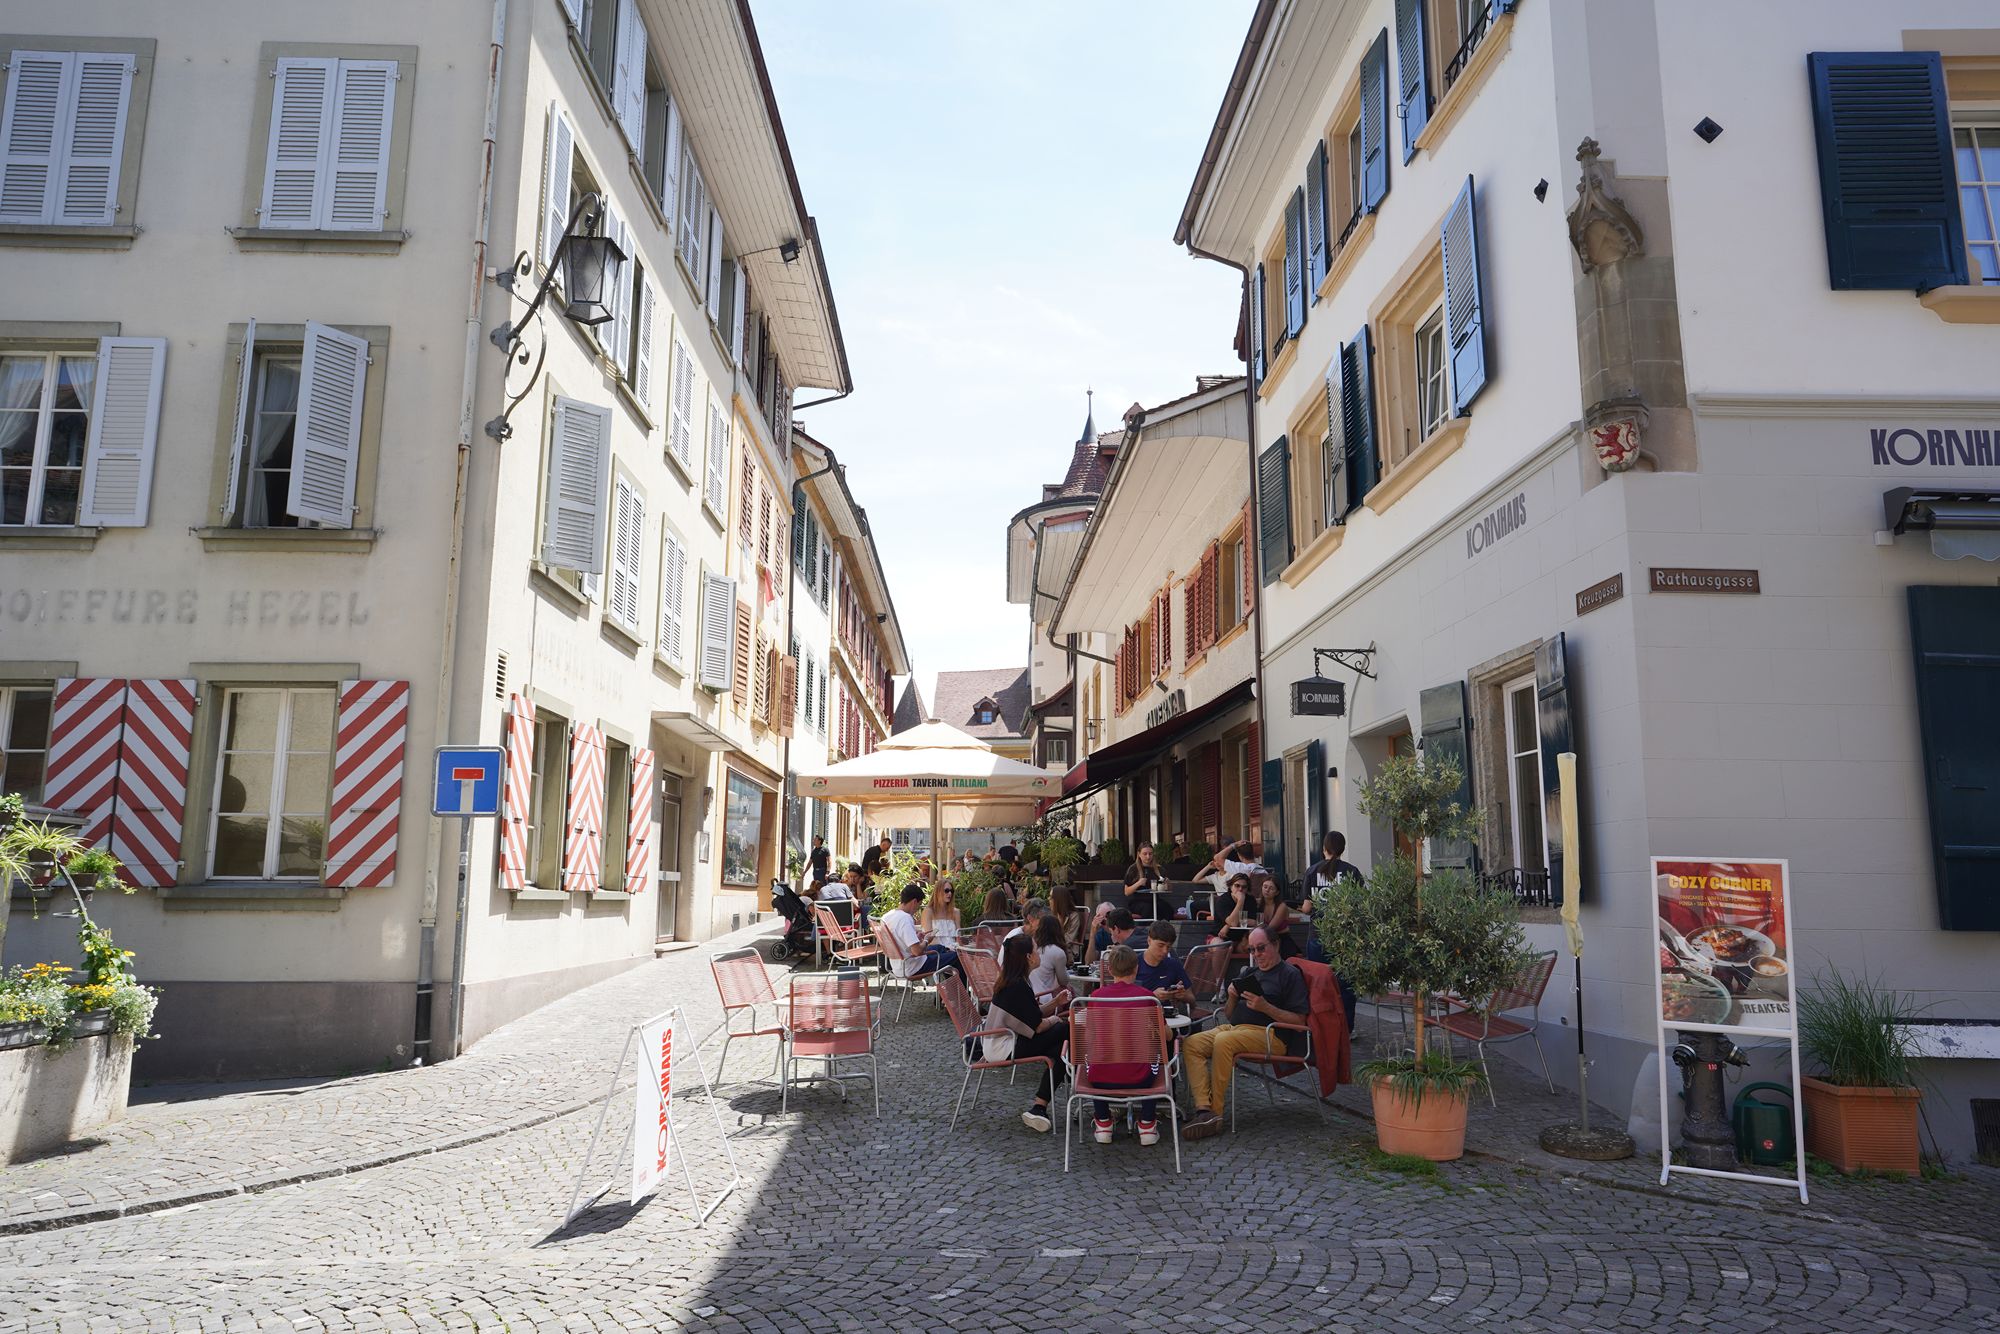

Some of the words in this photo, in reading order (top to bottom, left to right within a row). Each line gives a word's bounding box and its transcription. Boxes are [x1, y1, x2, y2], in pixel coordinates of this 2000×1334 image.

[1466, 492, 1527, 560] KORNHAUS
[1655, 571, 1753, 590] Rathausgasse
[1579, 583, 1618, 609] Kreuzgasse
[224, 590, 370, 626] HEZEL
[1301, 692, 1340, 704] KORNHAUS
[873, 778, 909, 788] PIZZERIA
[912, 778, 949, 788] TAVERNA
[952, 778, 988, 788] ITALIANA
[1668, 875, 1707, 889] COZY
[1709, 877, 1772, 892] CORNER
